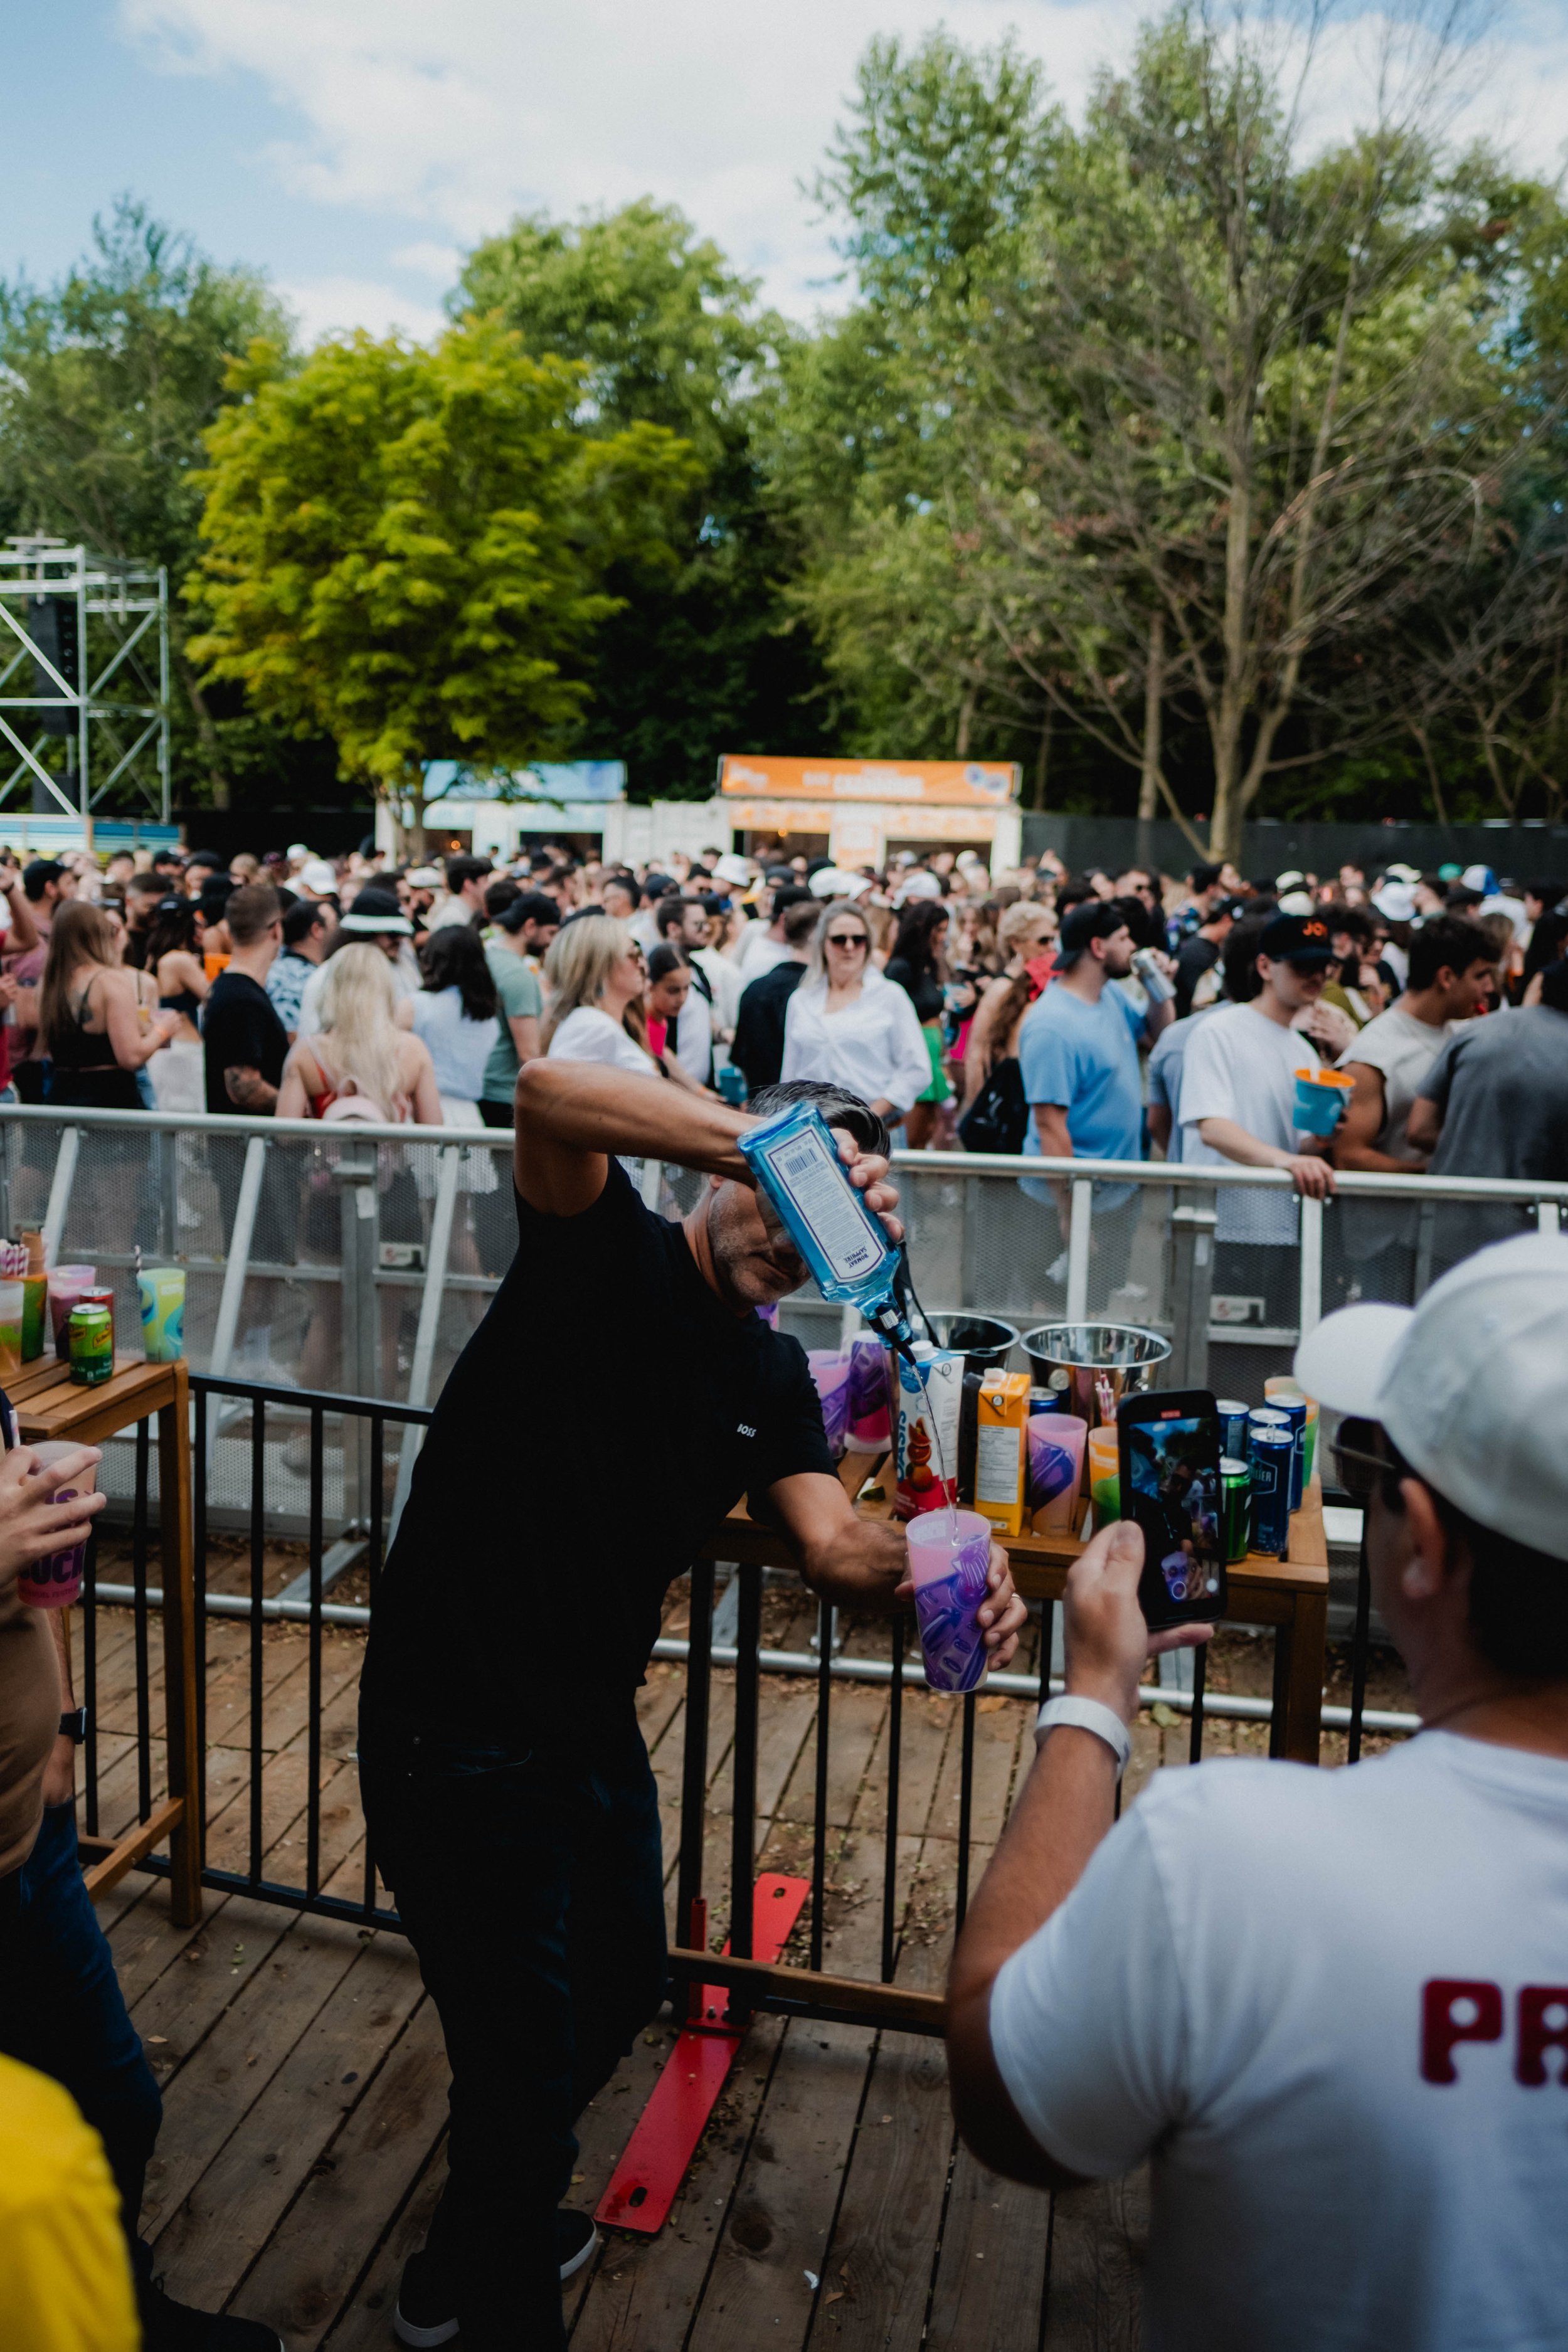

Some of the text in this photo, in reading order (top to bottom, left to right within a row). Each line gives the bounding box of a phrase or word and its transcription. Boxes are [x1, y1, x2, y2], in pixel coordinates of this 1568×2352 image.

[843, 1246, 867, 1263] SAPPHIRE
[848, 1253, 869, 1268] BOMBAY
[736, 1423, 757, 1438] BOSS
